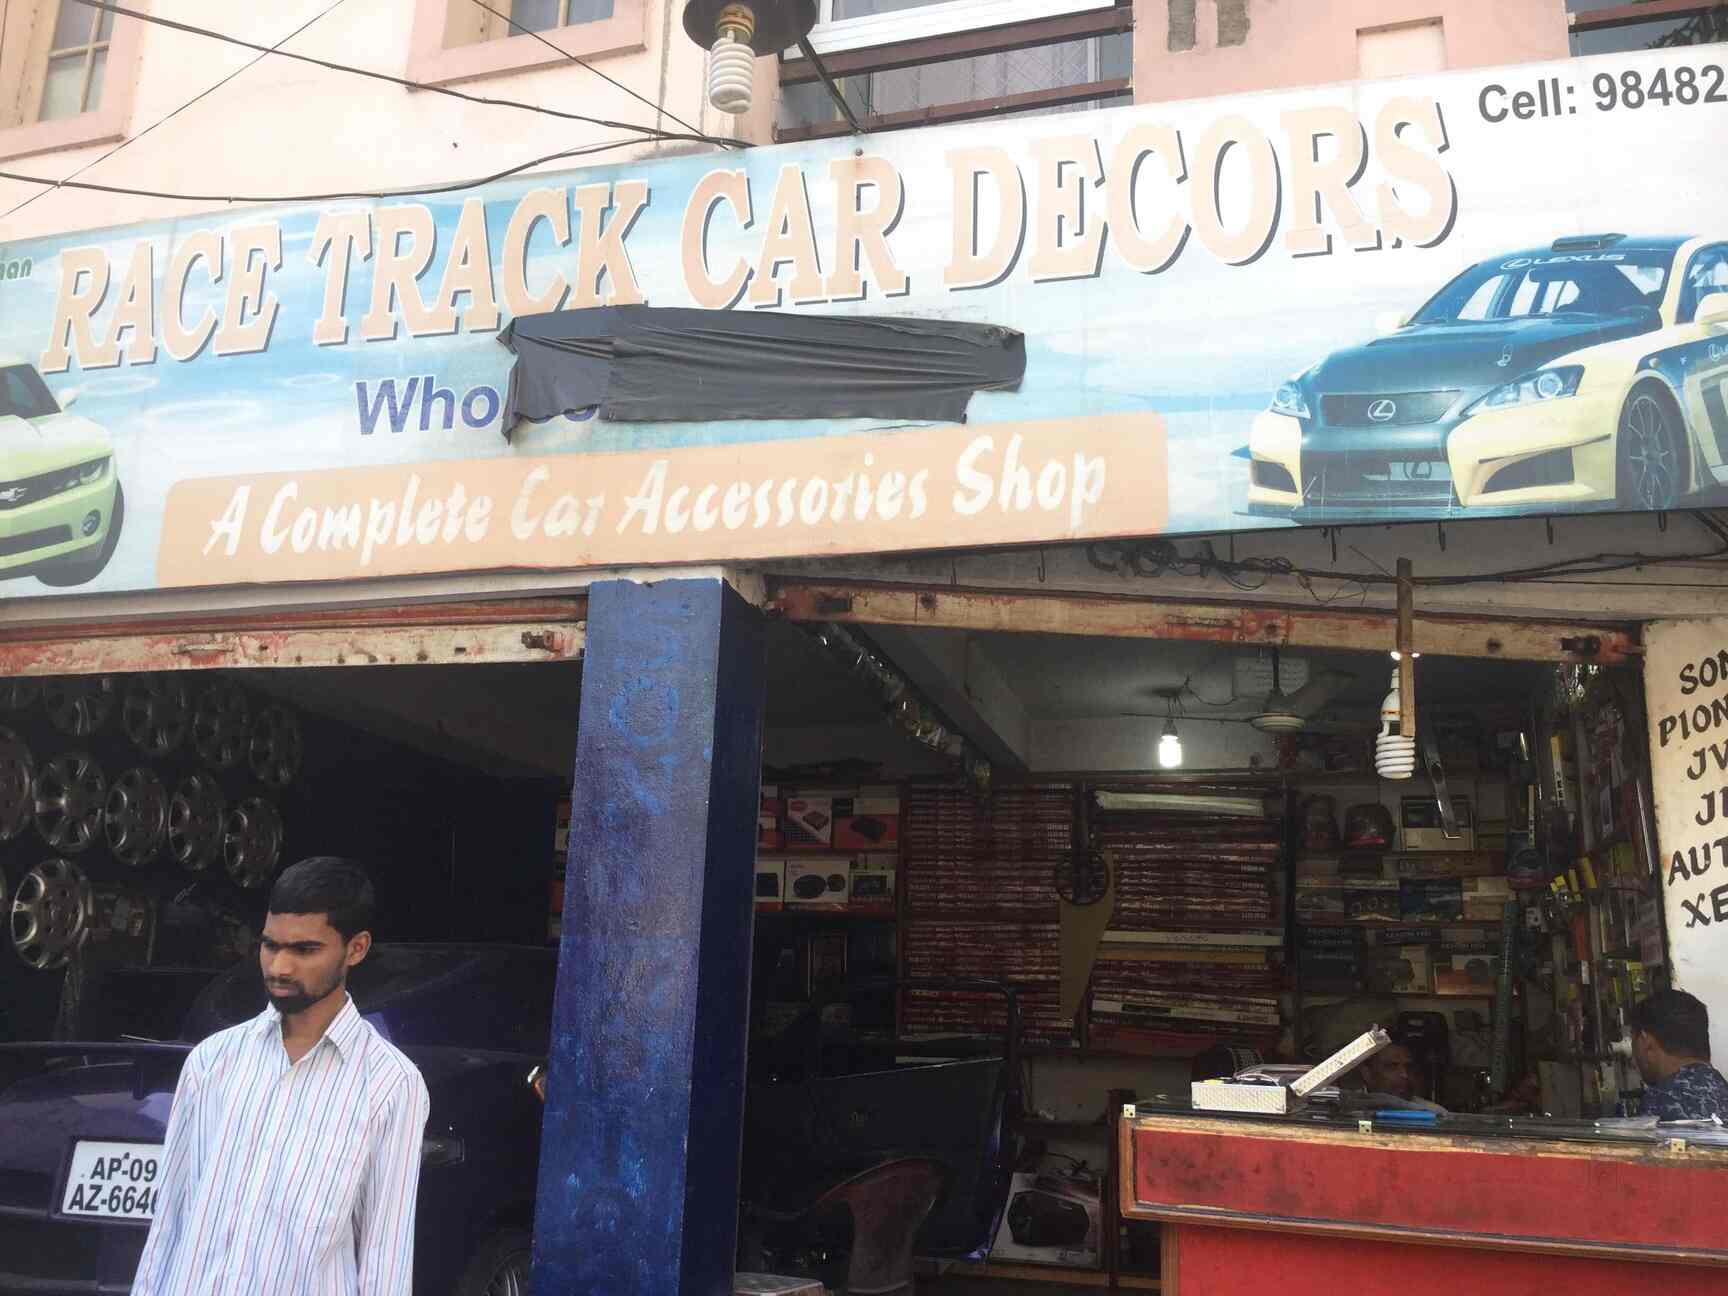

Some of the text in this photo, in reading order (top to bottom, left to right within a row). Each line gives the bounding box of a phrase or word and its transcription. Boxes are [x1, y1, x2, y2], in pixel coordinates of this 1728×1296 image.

[1478, 64, 1728, 123] Cell: 98482
[40, 95, 1459, 374] RACE TRACK CAR DECORS
[202, 433, 1106, 567] A Complete Car Accessories Shop
[68, 1183, 158, 1215] AZ-664
[90, 1156, 157, 1183] AP-09
